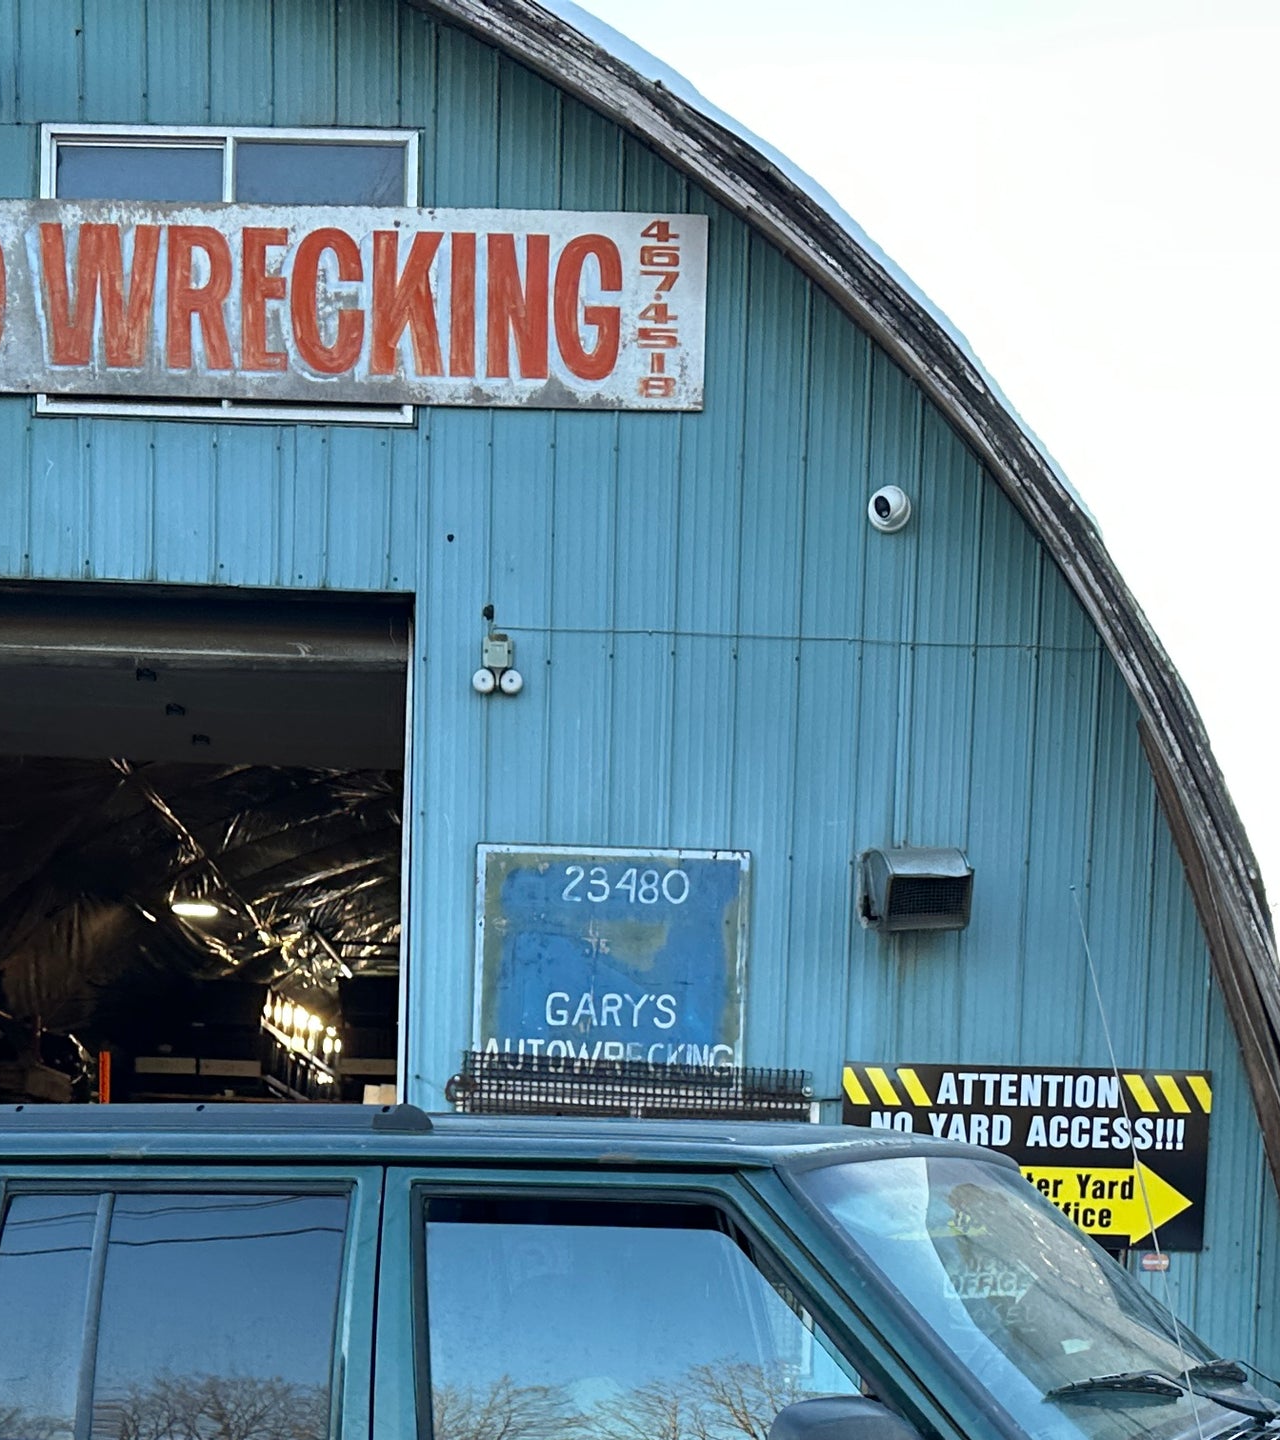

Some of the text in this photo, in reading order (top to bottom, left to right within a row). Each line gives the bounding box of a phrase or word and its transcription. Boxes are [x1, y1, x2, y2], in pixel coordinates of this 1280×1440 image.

[39, 221, 623, 381] WRECKING
[561, 865, 690, 905] 23480
[545, 991, 677, 1029] GARY'S
[936, 1071, 1120, 1109] ATTENTION
[927, 1112, 1012, 1146] YARD
[1026, 1115, 1186, 1151] ACCESS!!!
[1076, 1174, 1135, 1200] Yard
